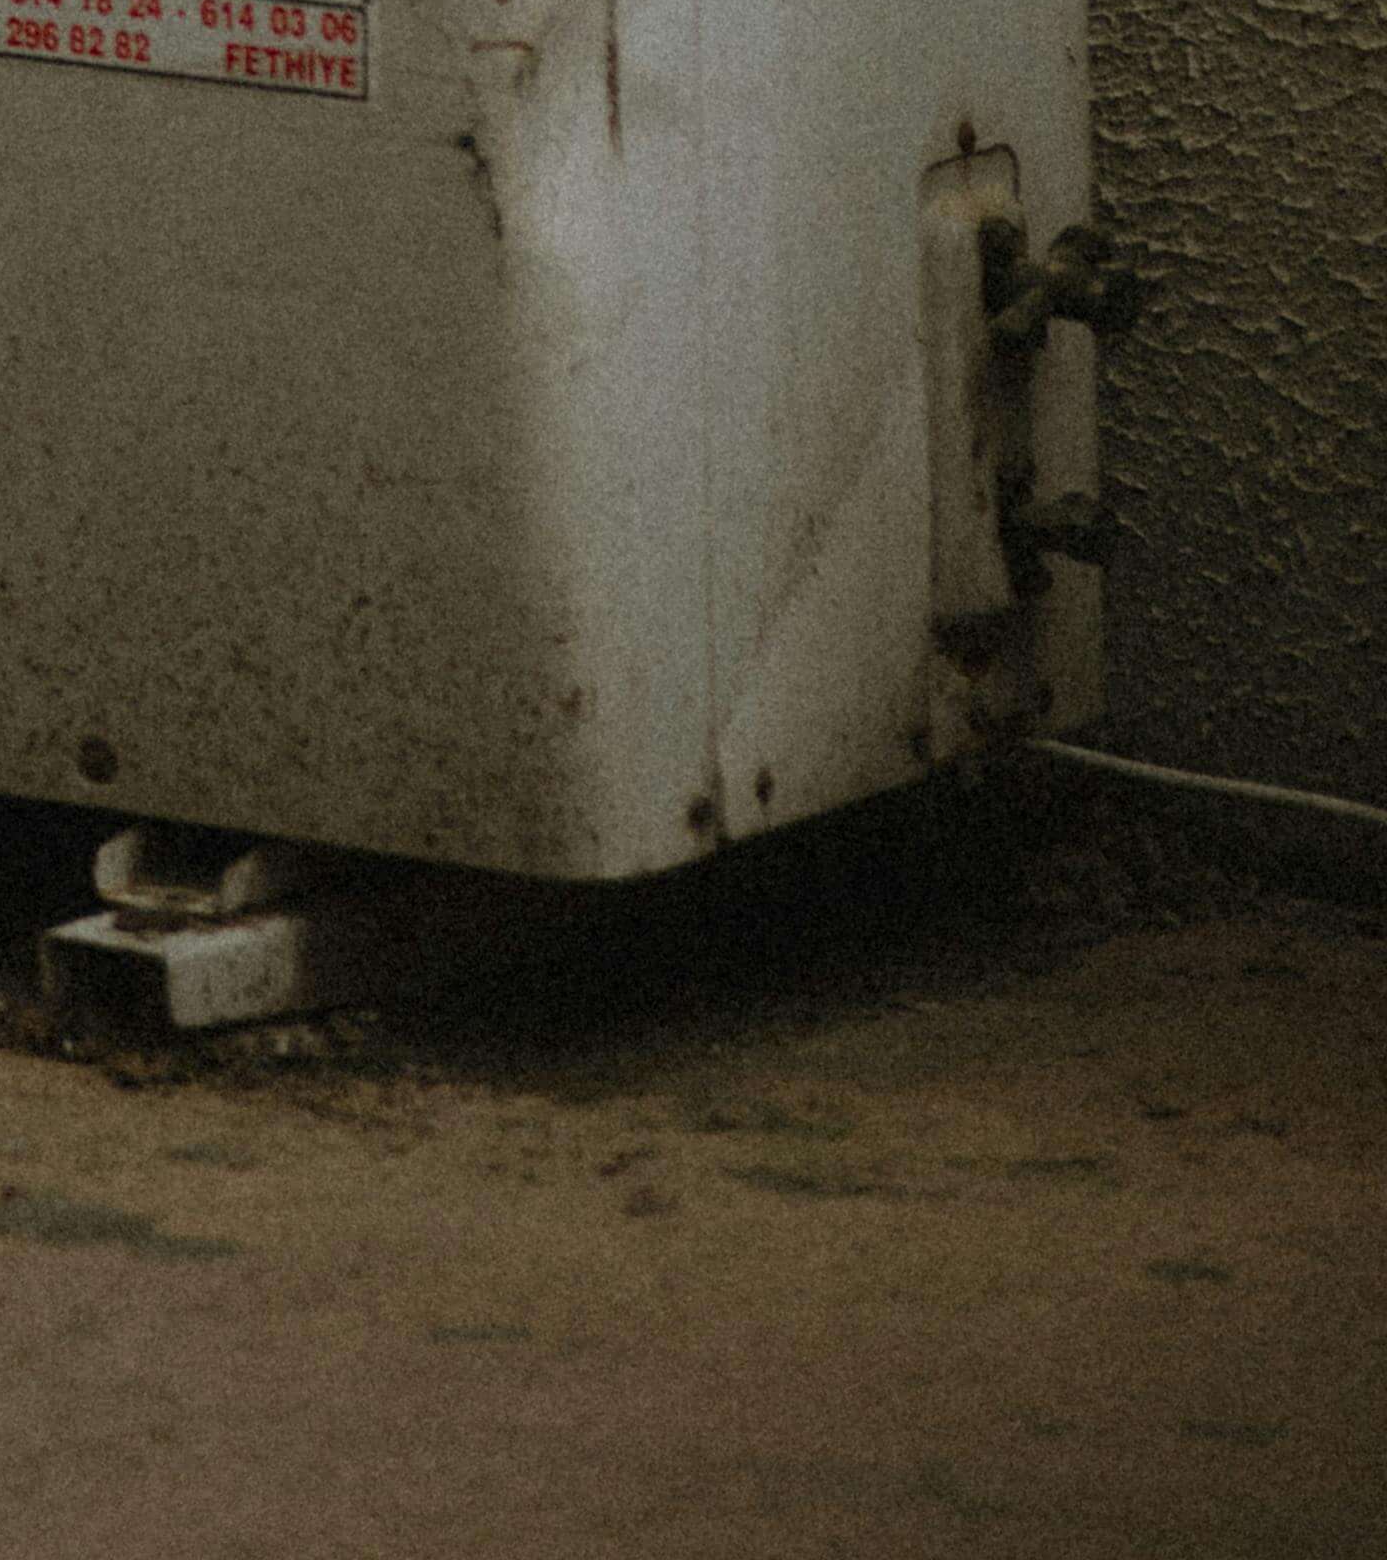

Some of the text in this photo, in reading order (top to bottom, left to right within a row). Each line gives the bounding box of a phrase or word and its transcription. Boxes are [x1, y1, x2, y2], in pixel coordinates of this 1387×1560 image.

[270, 4, 306, 39] 03
[321, 10, 358, 45] 06
[7, 17, 59, 53] 296
[69, 24, 104, 57] 82
[115, 30, 150, 63] 82
[225, 42, 357, 89] FETHİYE
